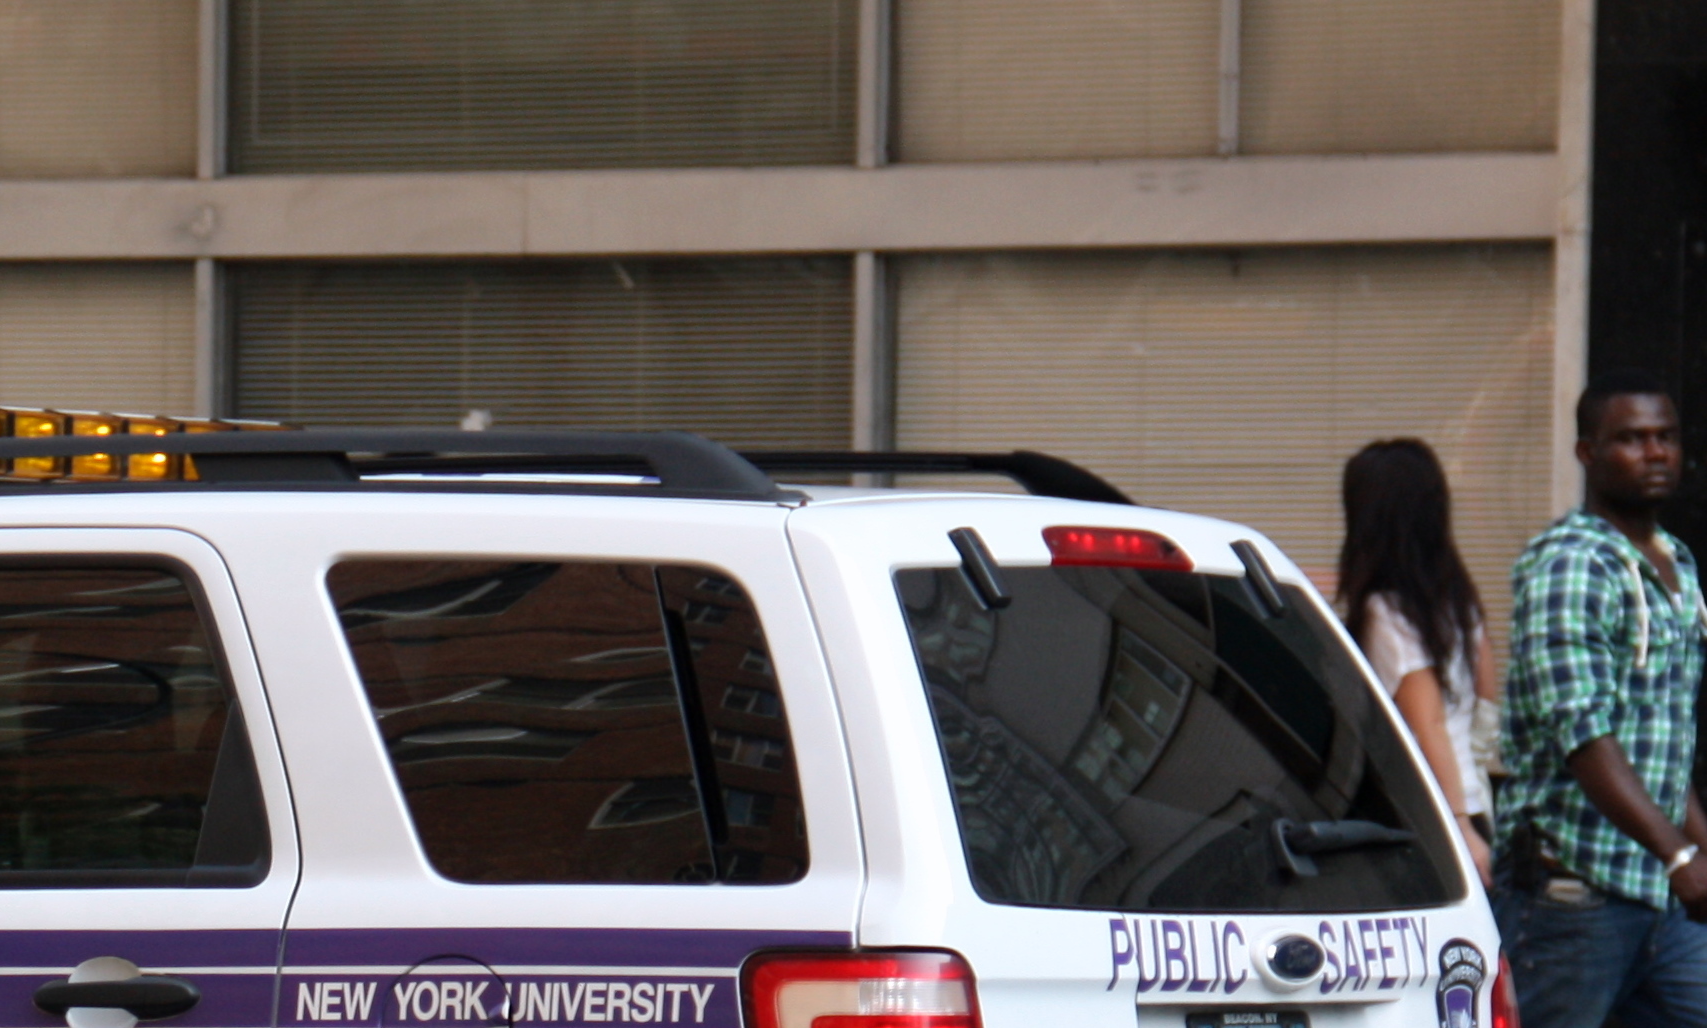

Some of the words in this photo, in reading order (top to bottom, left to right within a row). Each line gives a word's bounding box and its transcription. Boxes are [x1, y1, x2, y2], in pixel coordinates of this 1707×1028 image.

[1106, 918, 1249, 995] PUBLIC
[1319, 916, 1430, 995] SAFETY
[295, 981, 378, 1022] NEW
[393, 980, 490, 1022] YORK
[504, 981, 715, 1024] UNIVERSITY
